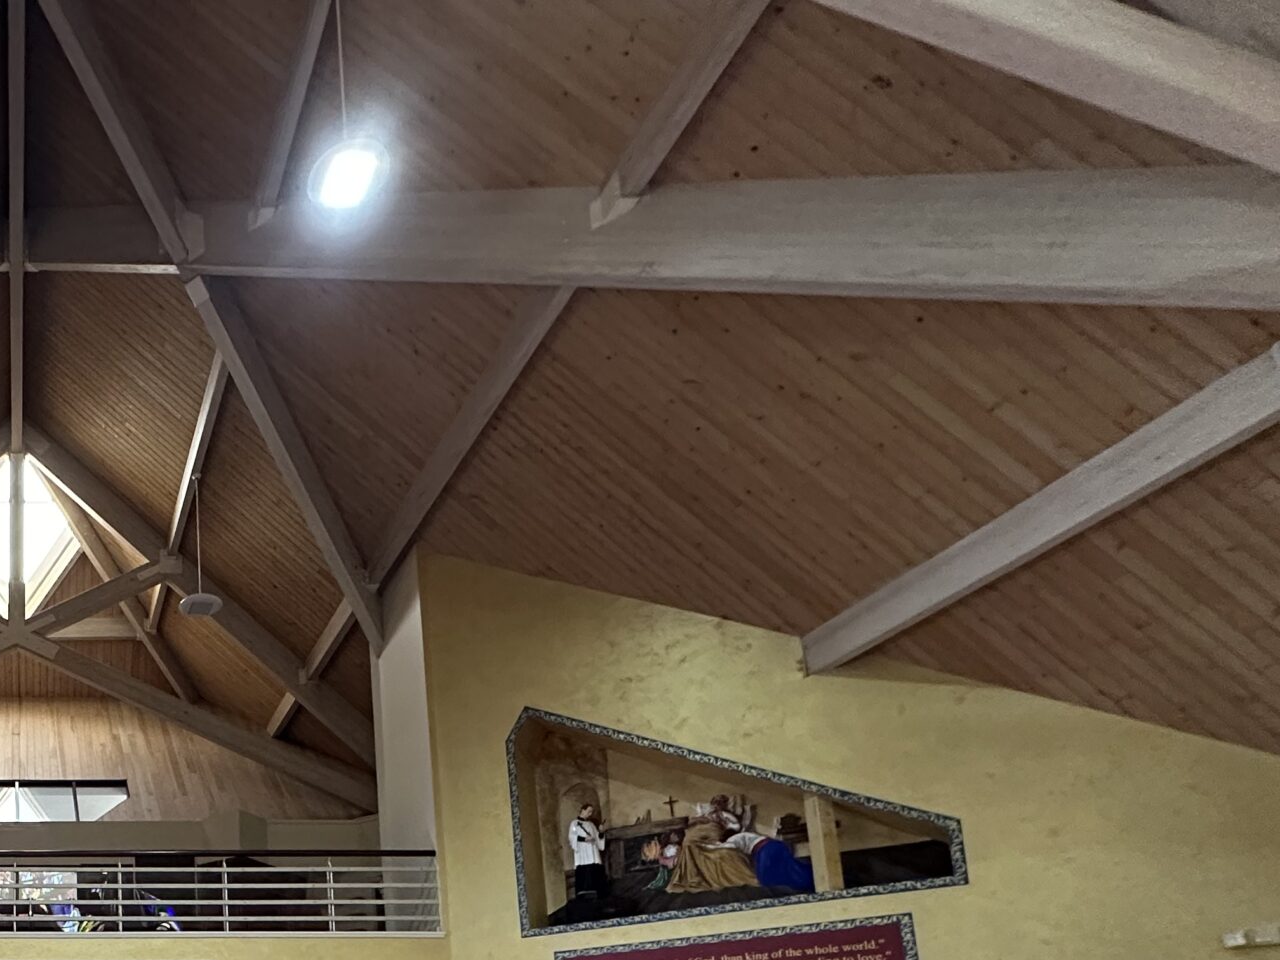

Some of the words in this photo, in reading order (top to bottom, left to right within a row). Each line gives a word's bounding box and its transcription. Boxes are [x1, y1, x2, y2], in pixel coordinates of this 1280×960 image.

[771, 948, 782, 958] of
[786, 948, 802, 957] the
[804, 944, 839, 954] whole
